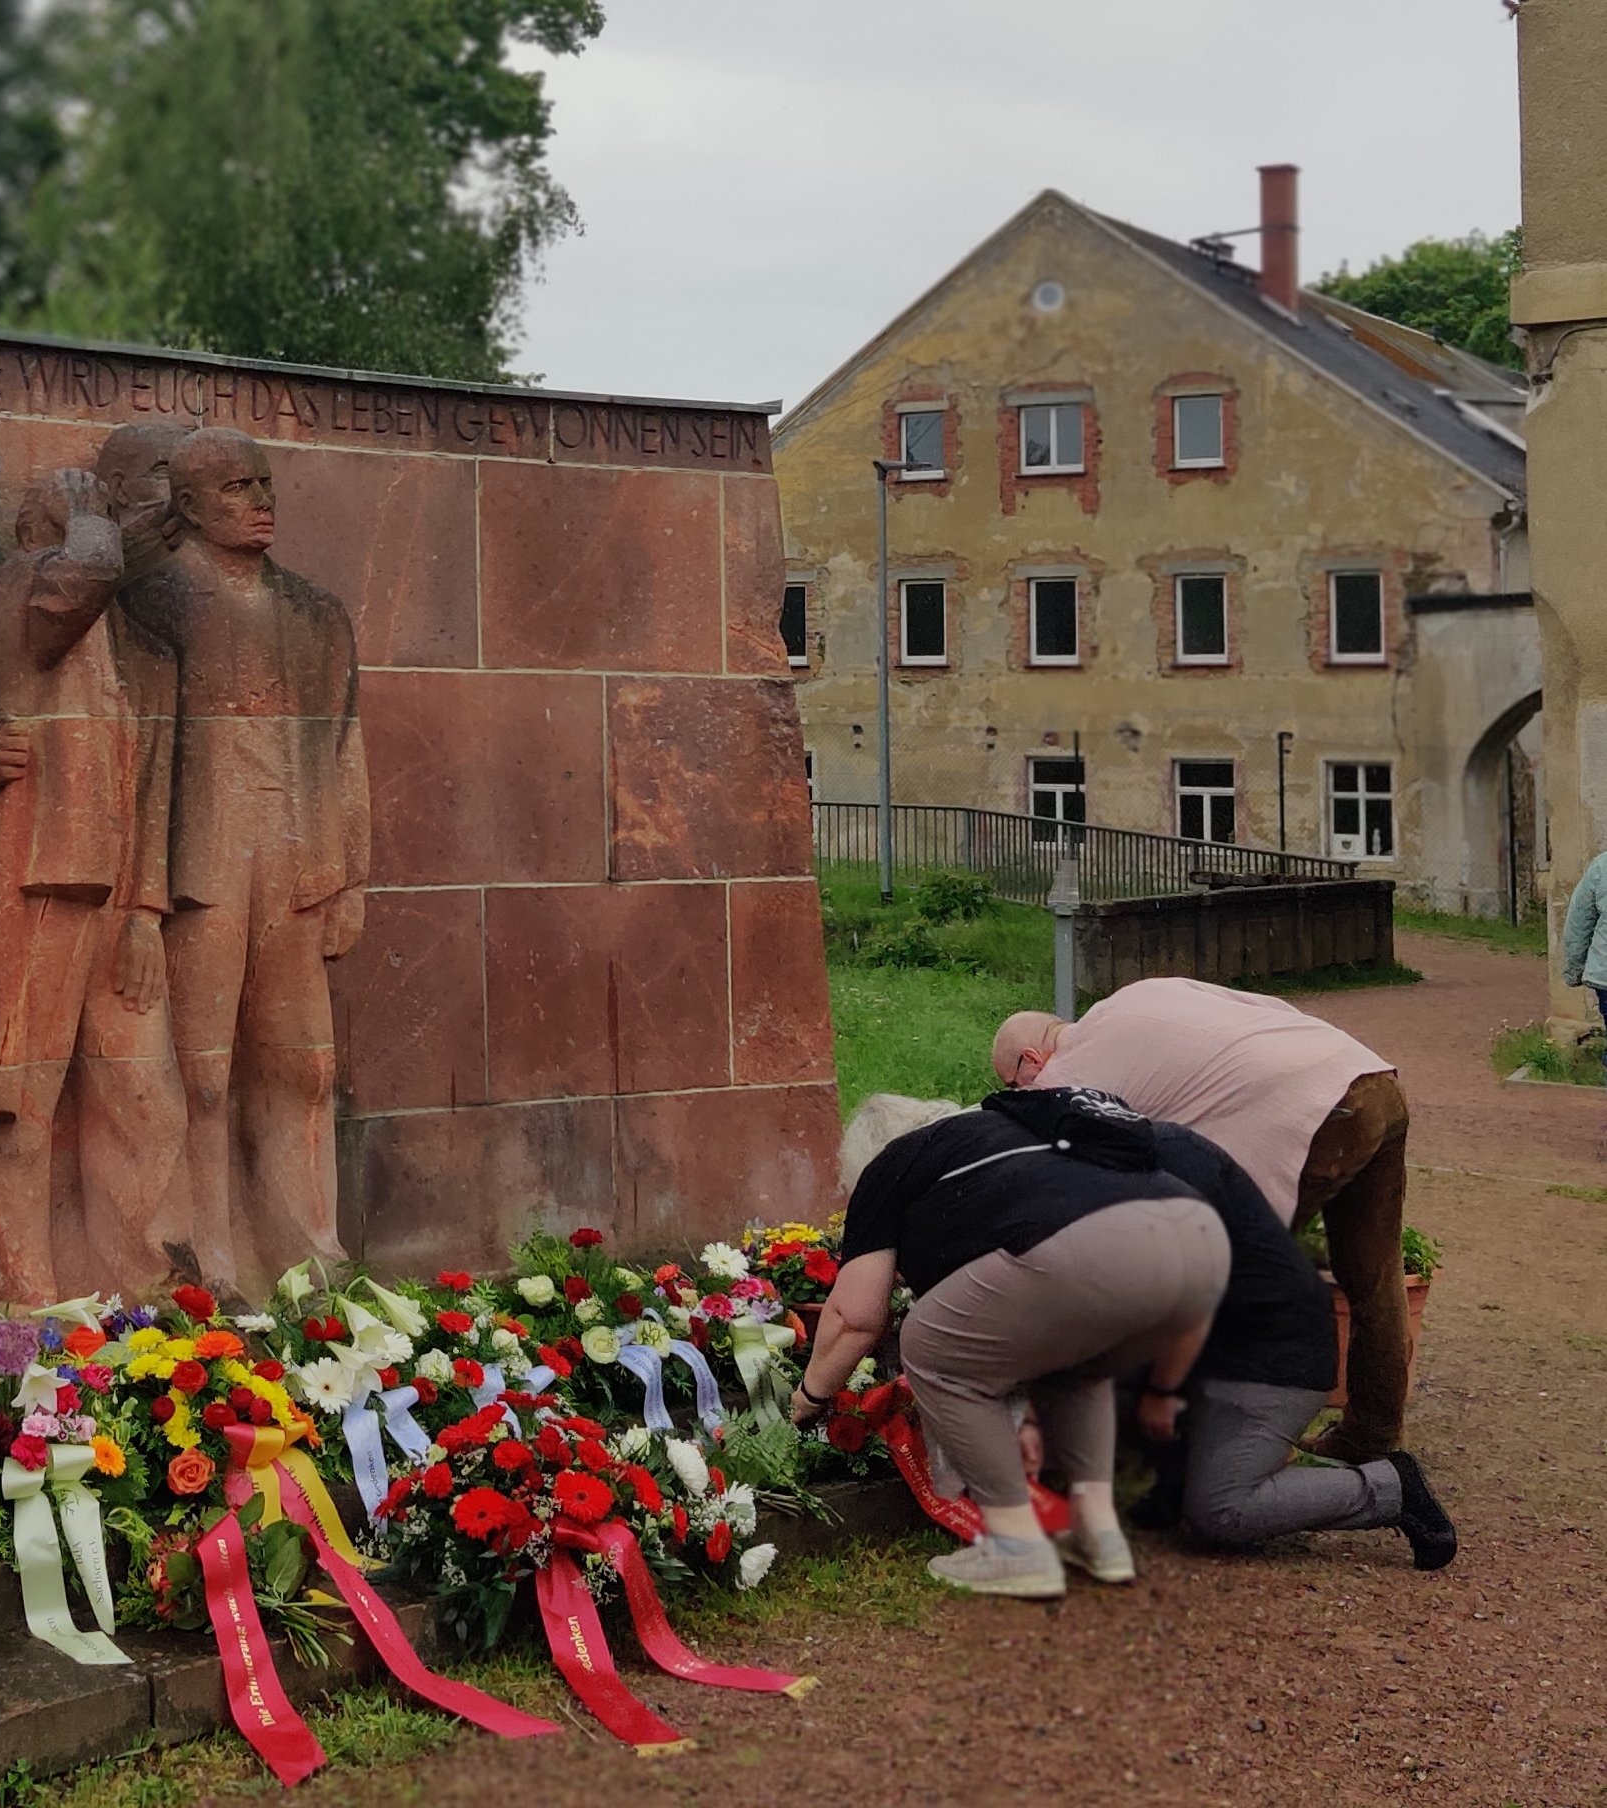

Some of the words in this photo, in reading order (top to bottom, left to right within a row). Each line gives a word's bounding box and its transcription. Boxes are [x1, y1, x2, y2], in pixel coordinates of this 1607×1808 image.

[16, 350, 121, 409] WIRD
[130, 363, 240, 420] EUCH
[250, 376, 321, 428] DAS
[331, 386, 441, 436] LEBEN
[452, 400, 682, 456] GEWONNEN
[690, 414, 759, 460] SEIN
[567, 1615, 594, 1672] edenken
[258, 1708, 277, 1726] Die
